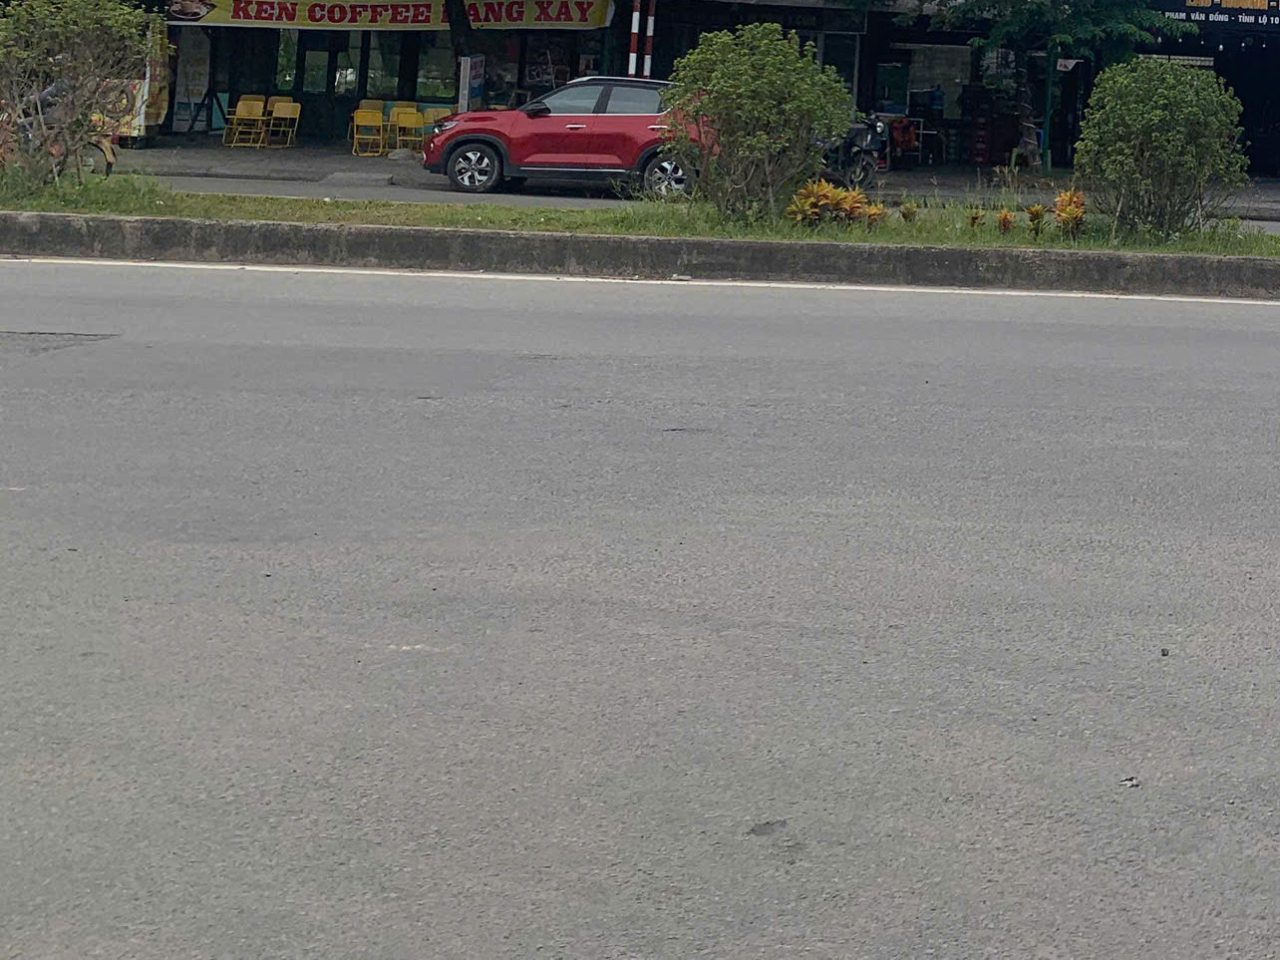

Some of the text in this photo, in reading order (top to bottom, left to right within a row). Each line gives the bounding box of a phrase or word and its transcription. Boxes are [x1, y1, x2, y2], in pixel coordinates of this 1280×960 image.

[231, 0, 298, 22] KEN
[307, 2, 432, 23] COFFEE
[534, 0, 594, 22] XAY
[1270, 16, 1280, 25] 10
